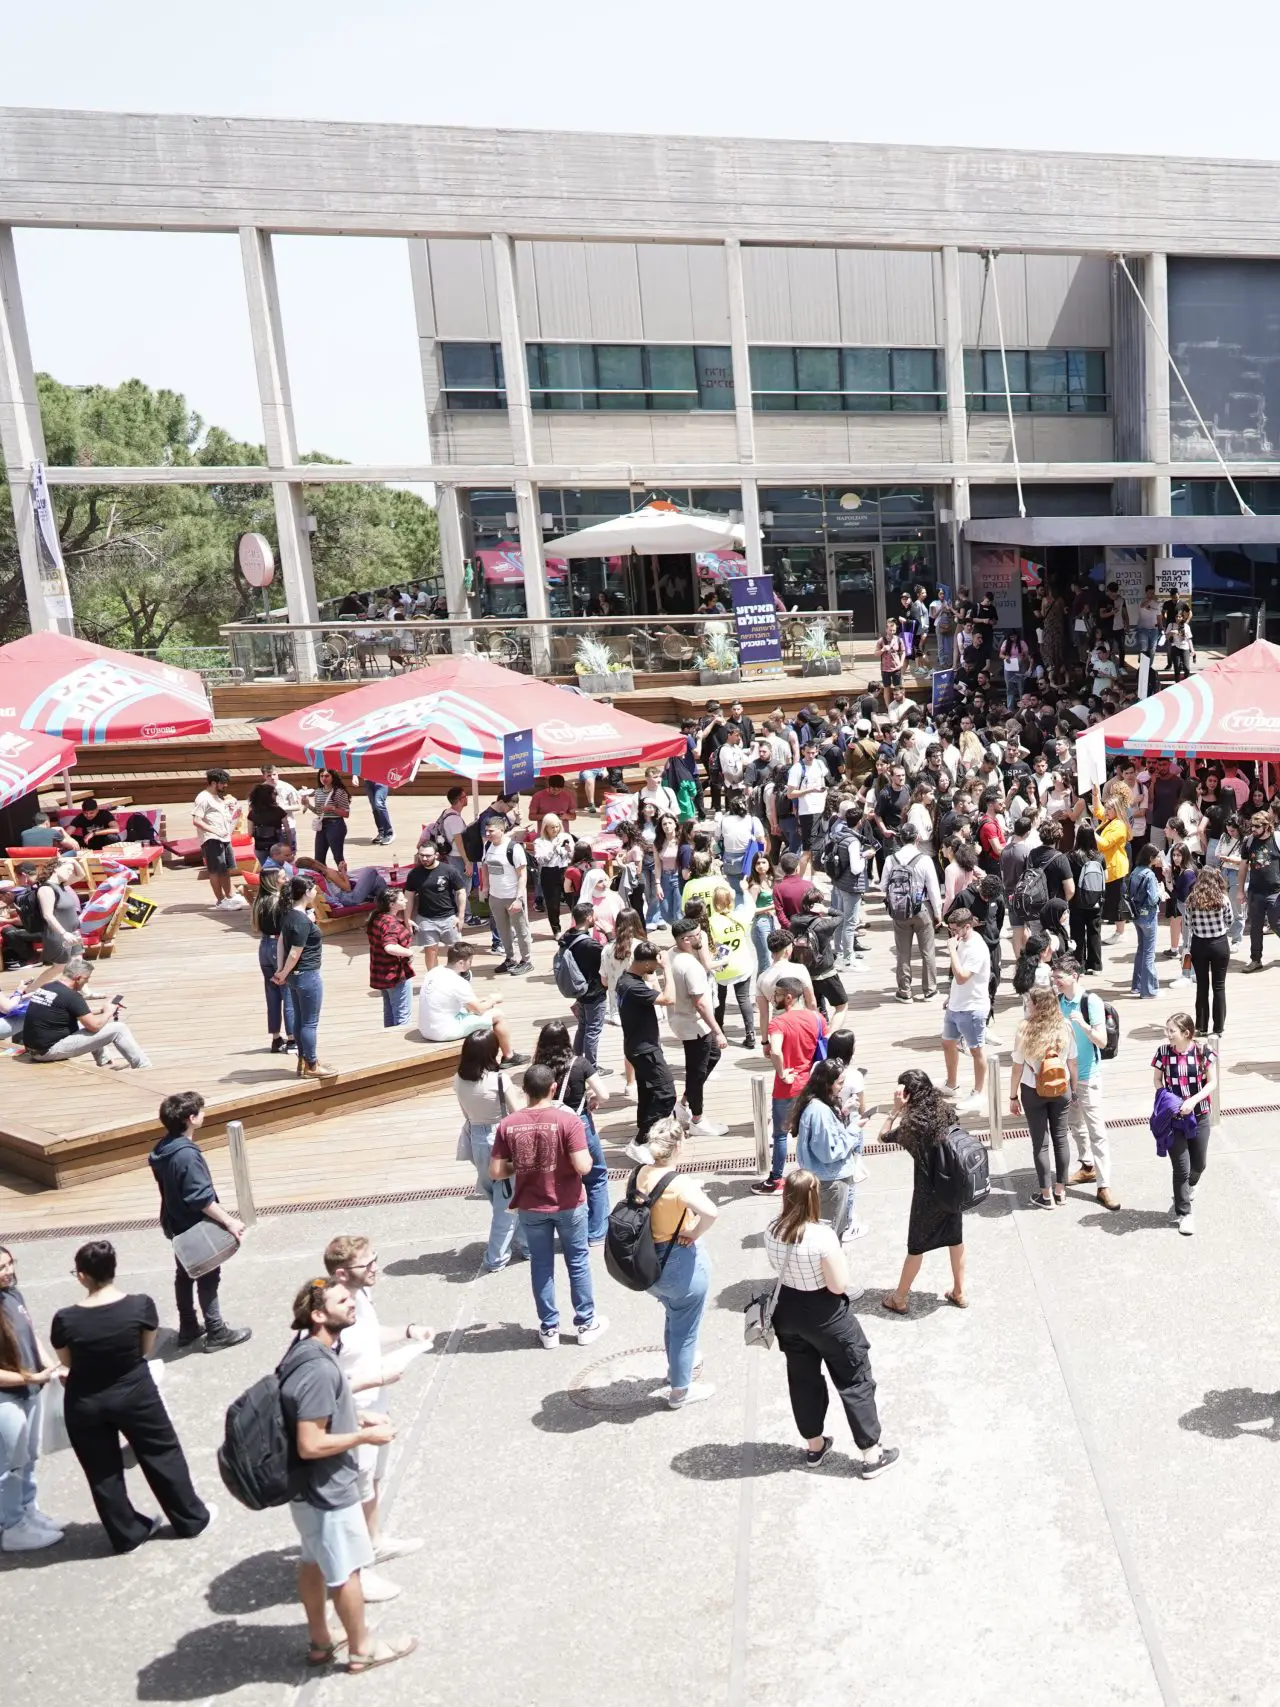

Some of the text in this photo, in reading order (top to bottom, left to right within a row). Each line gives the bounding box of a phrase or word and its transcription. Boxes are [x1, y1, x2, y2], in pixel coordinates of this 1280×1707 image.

[1115, 571, 1142, 579] ברוכים
[736, 603, 774, 615] האירוע
[737, 613, 775, 626] מצולם
[740, 638, 778, 650] של הטכניון
